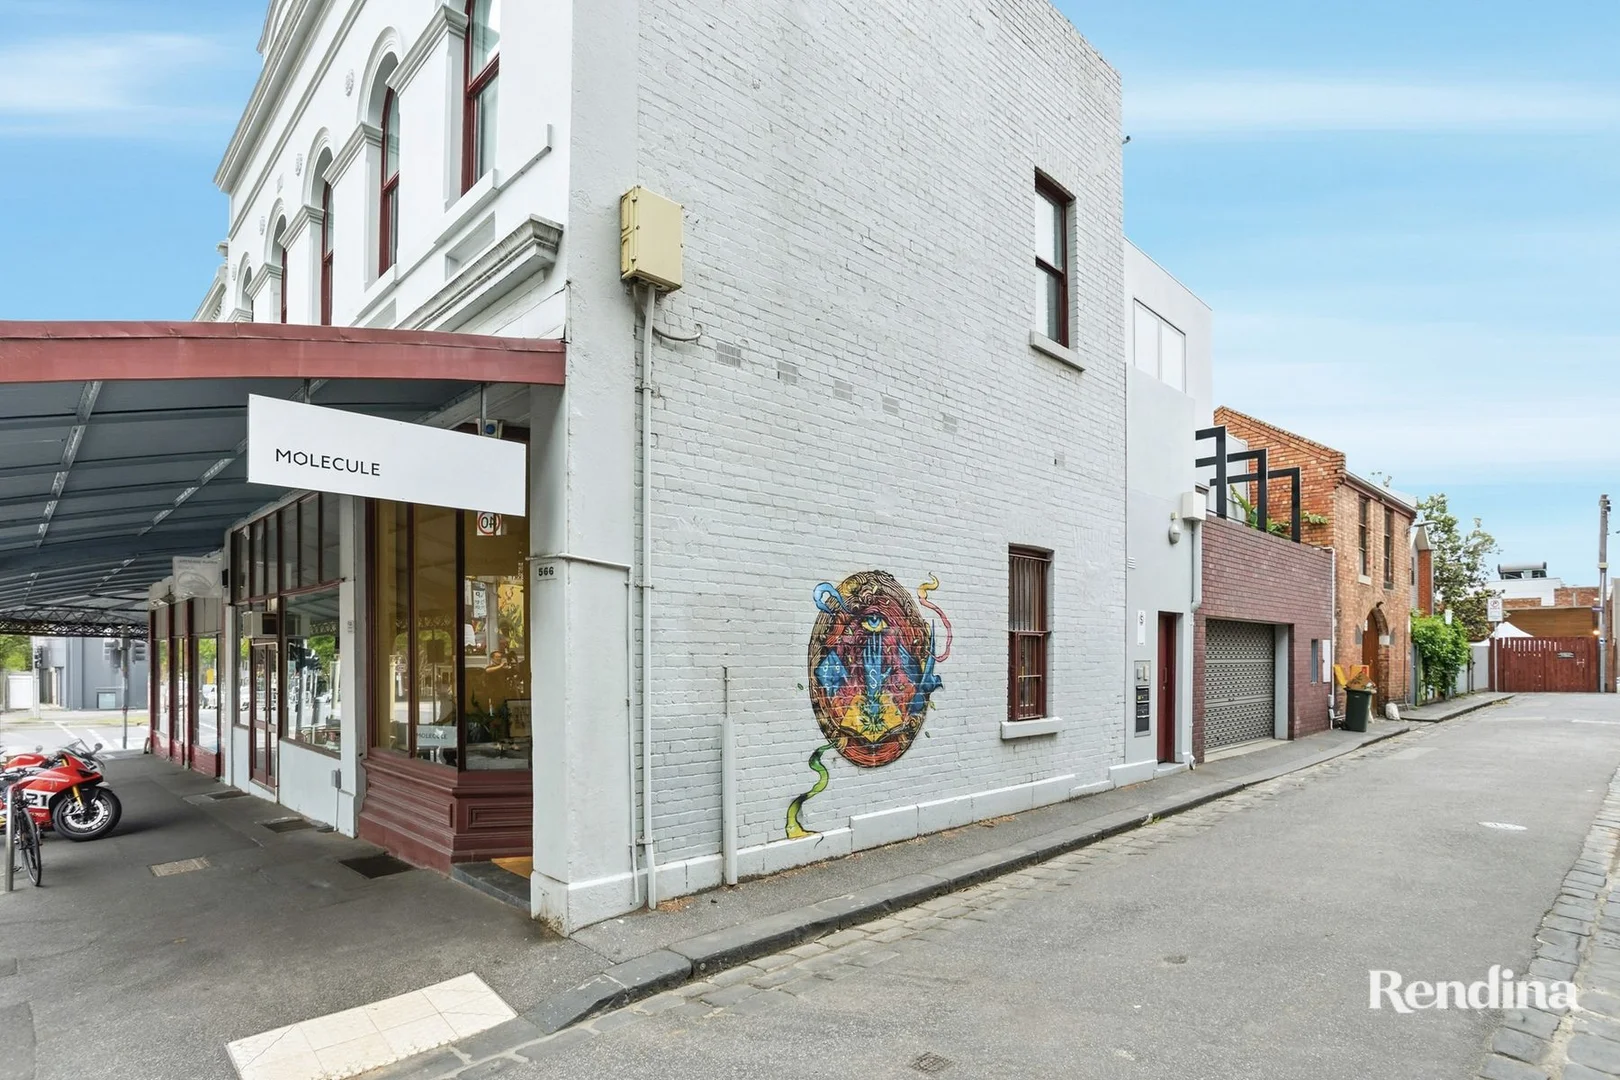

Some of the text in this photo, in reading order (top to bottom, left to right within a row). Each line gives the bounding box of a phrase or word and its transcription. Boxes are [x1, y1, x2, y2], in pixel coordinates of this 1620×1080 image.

[275, 448, 381, 476] MOLECULE
[538, 566, 555, 577] 566
[26, 793, 48, 807] 21
